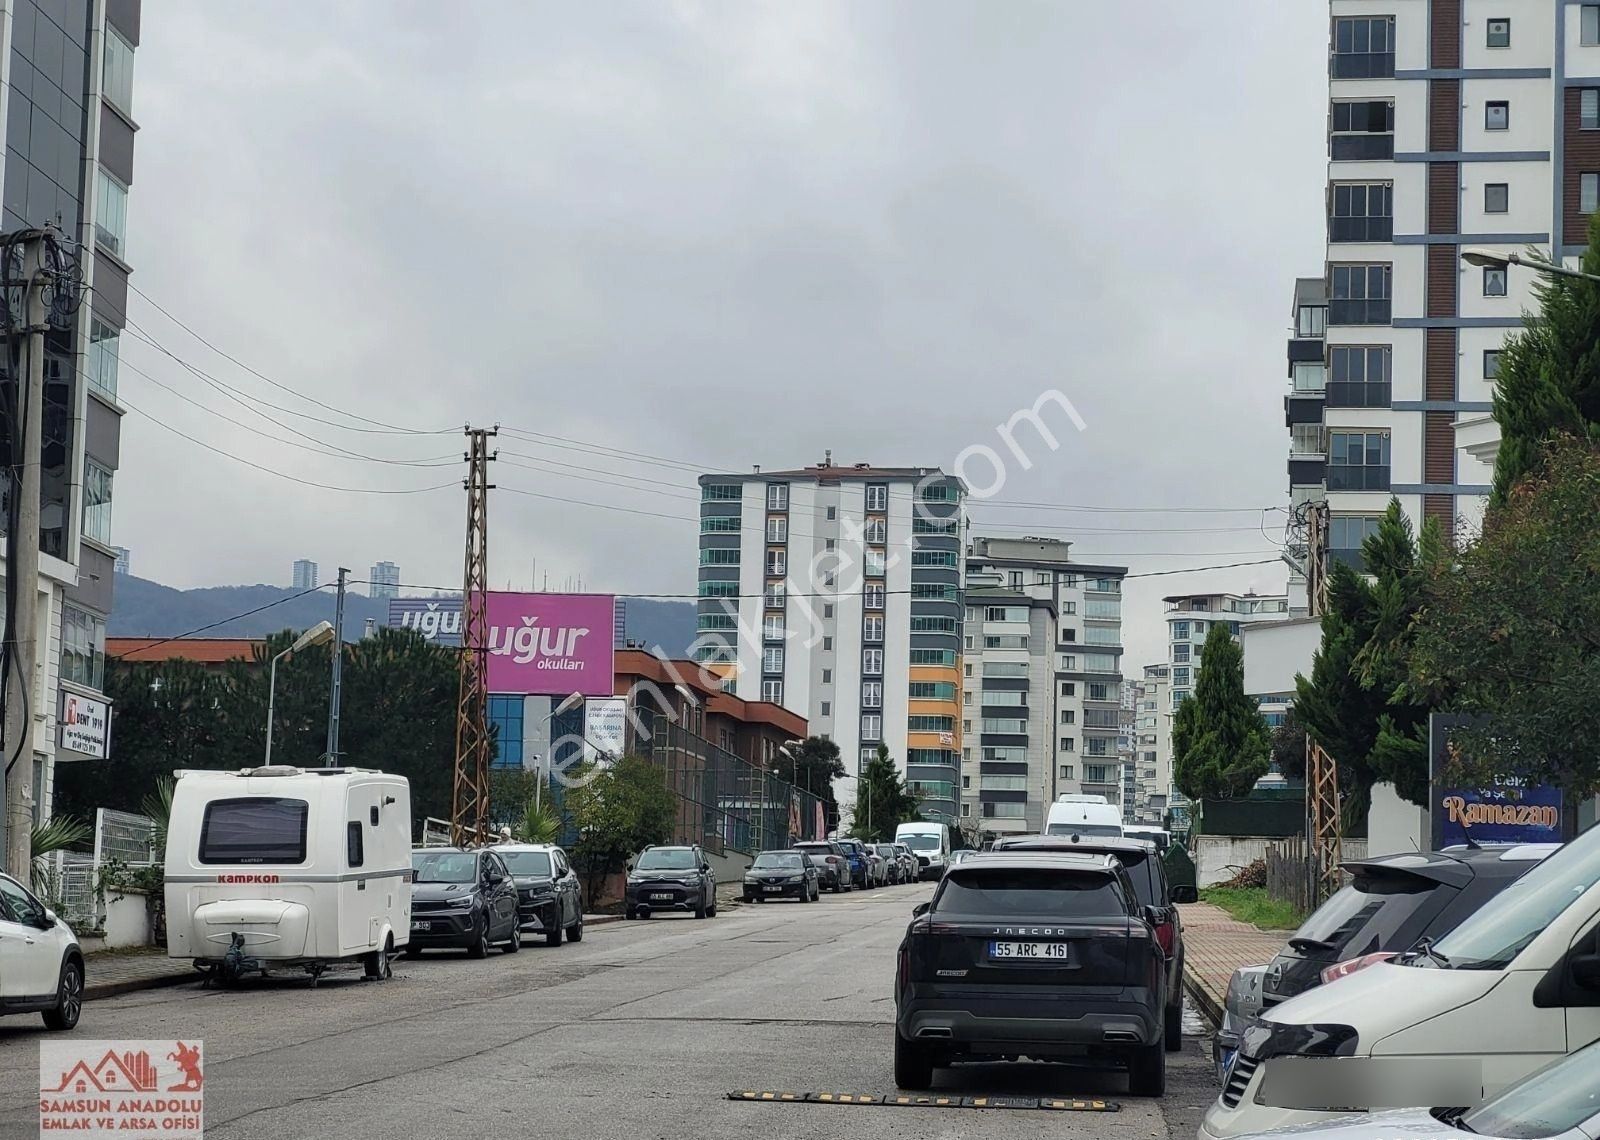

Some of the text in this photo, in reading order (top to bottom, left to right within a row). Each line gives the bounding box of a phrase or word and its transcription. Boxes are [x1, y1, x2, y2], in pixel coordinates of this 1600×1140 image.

[401, 602, 463, 640] uğu
[488, 616, 590, 664] uğur
[537, 658, 584, 670] okulları
[76, 712, 89, 726] DENT
[1442, 796, 1558, 832] Ramazan
[997, 943, 1011, 956] 55
[1016, 944, 1038, 957] ARC
[1045, 944, 1064, 957] 416
